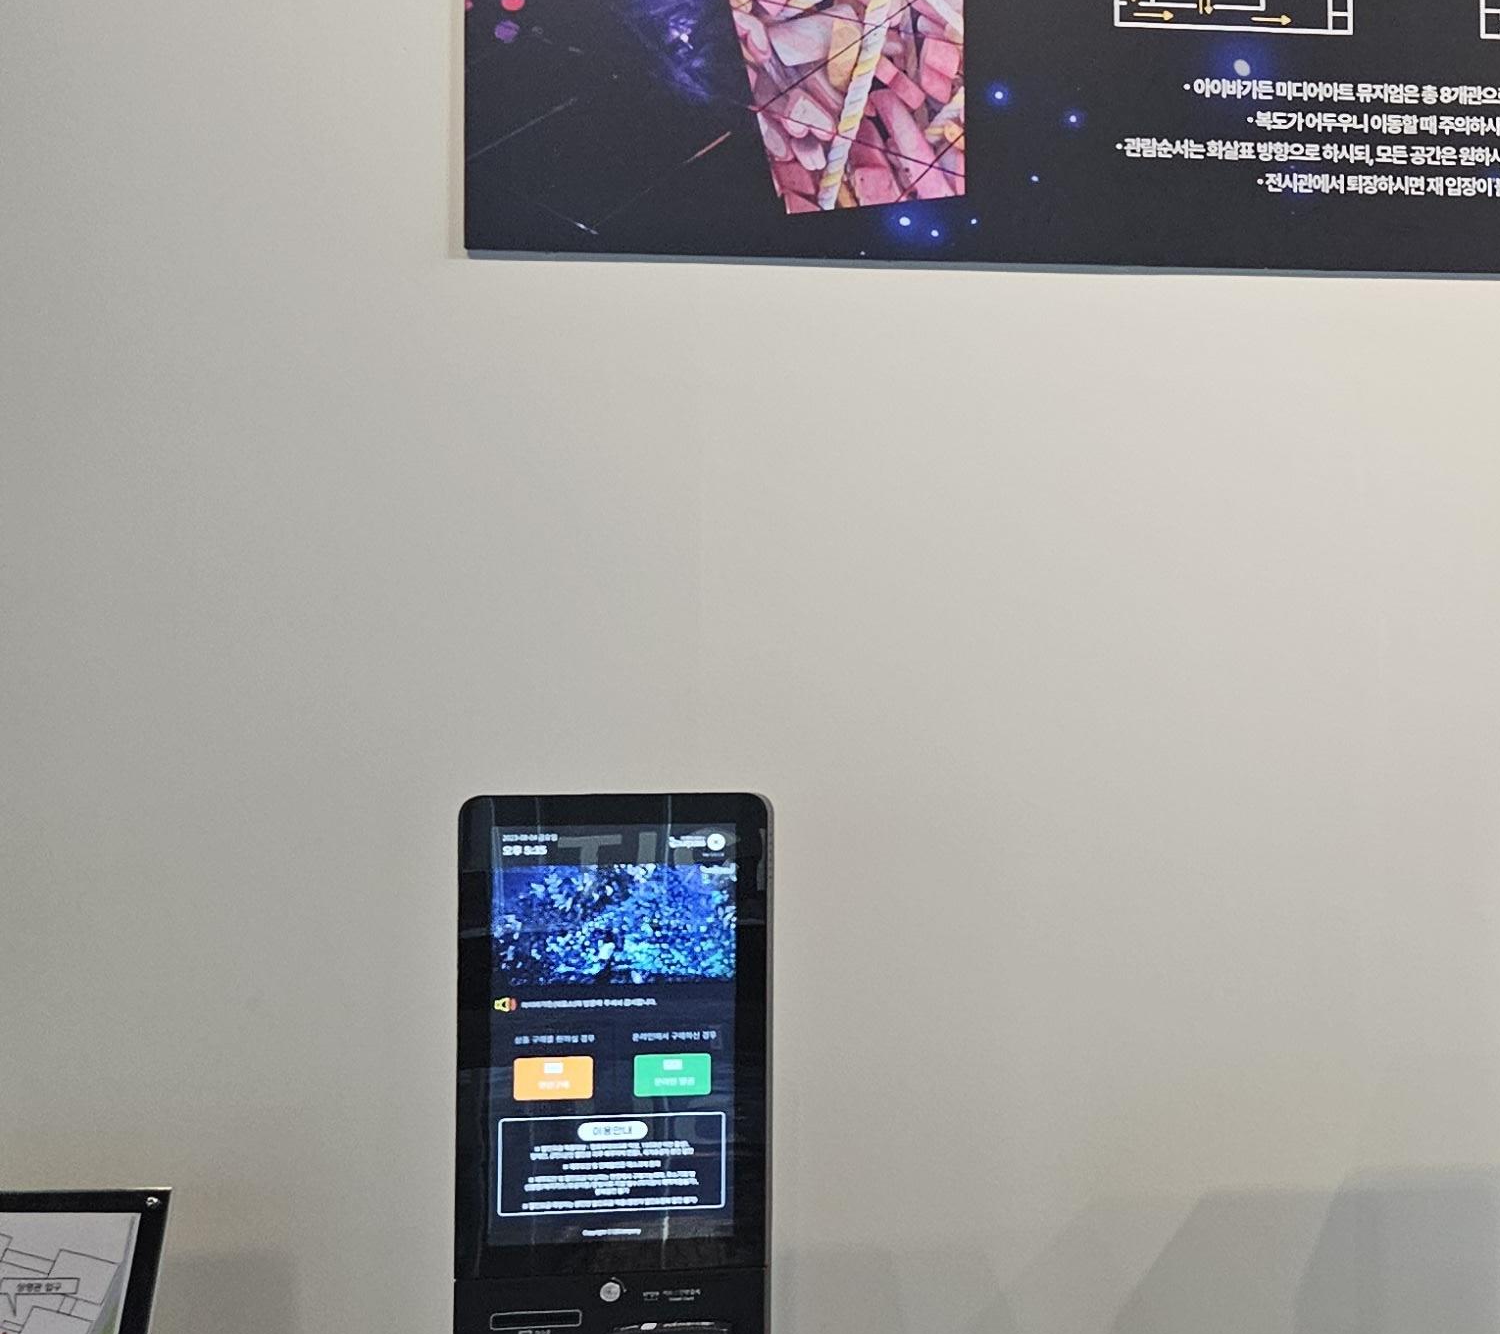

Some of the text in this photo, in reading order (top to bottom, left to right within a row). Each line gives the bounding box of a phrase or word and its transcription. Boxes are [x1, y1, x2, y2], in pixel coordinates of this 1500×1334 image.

[1193, 78, 1274, 100] 아이바가든
[1275, 81, 1355, 102] 미디어아트
[1356, 83, 1419, 104] 뮤지엄은
[1421, 85, 1438, 105] 총
[1254, 110, 1304, 131] 복도가
[1305, 112, 1369, 133] 어두우니
[1370, 113, 1419, 135] 이동할
[1420, 115, 1437, 135] 때
[1123, 137, 1205, 159] 관람순서는
[1206, 139, 1256, 161] 화살표
[1256, 141, 1322, 162] 방향으로
[1322, 143, 1374, 166] 하시되,
[1375, 144, 1408, 165] 모든
[1409, 145, 1458, 166] 공간은
[1265, 172, 1345, 194] 전시관에서
[1346, 174, 1425, 195] 퇴장하시면
